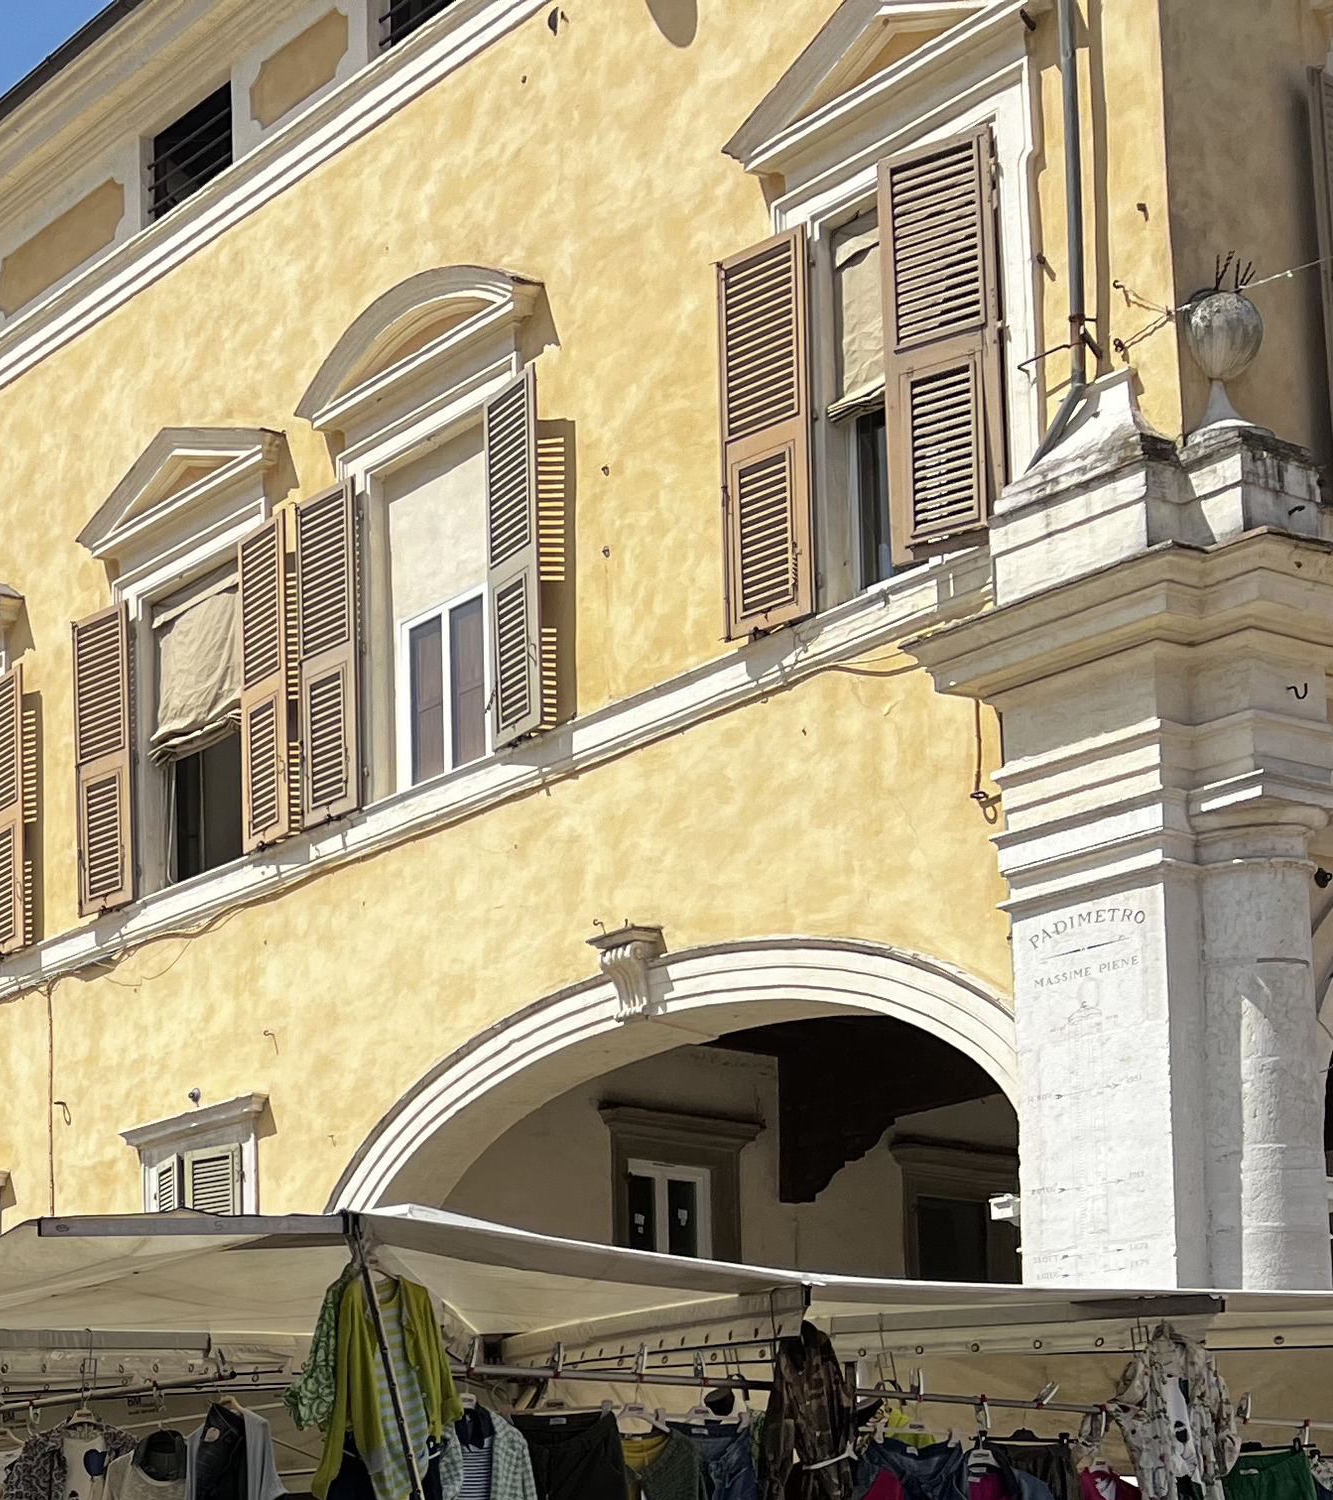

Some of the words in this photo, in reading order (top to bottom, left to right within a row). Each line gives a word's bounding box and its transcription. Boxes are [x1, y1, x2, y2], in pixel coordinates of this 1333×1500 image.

[1029, 908, 1146, 950] PADIMETRO
[1033, 966, 1092, 989] MASSIME
[1098, 955, 1140, 974] PIENE
